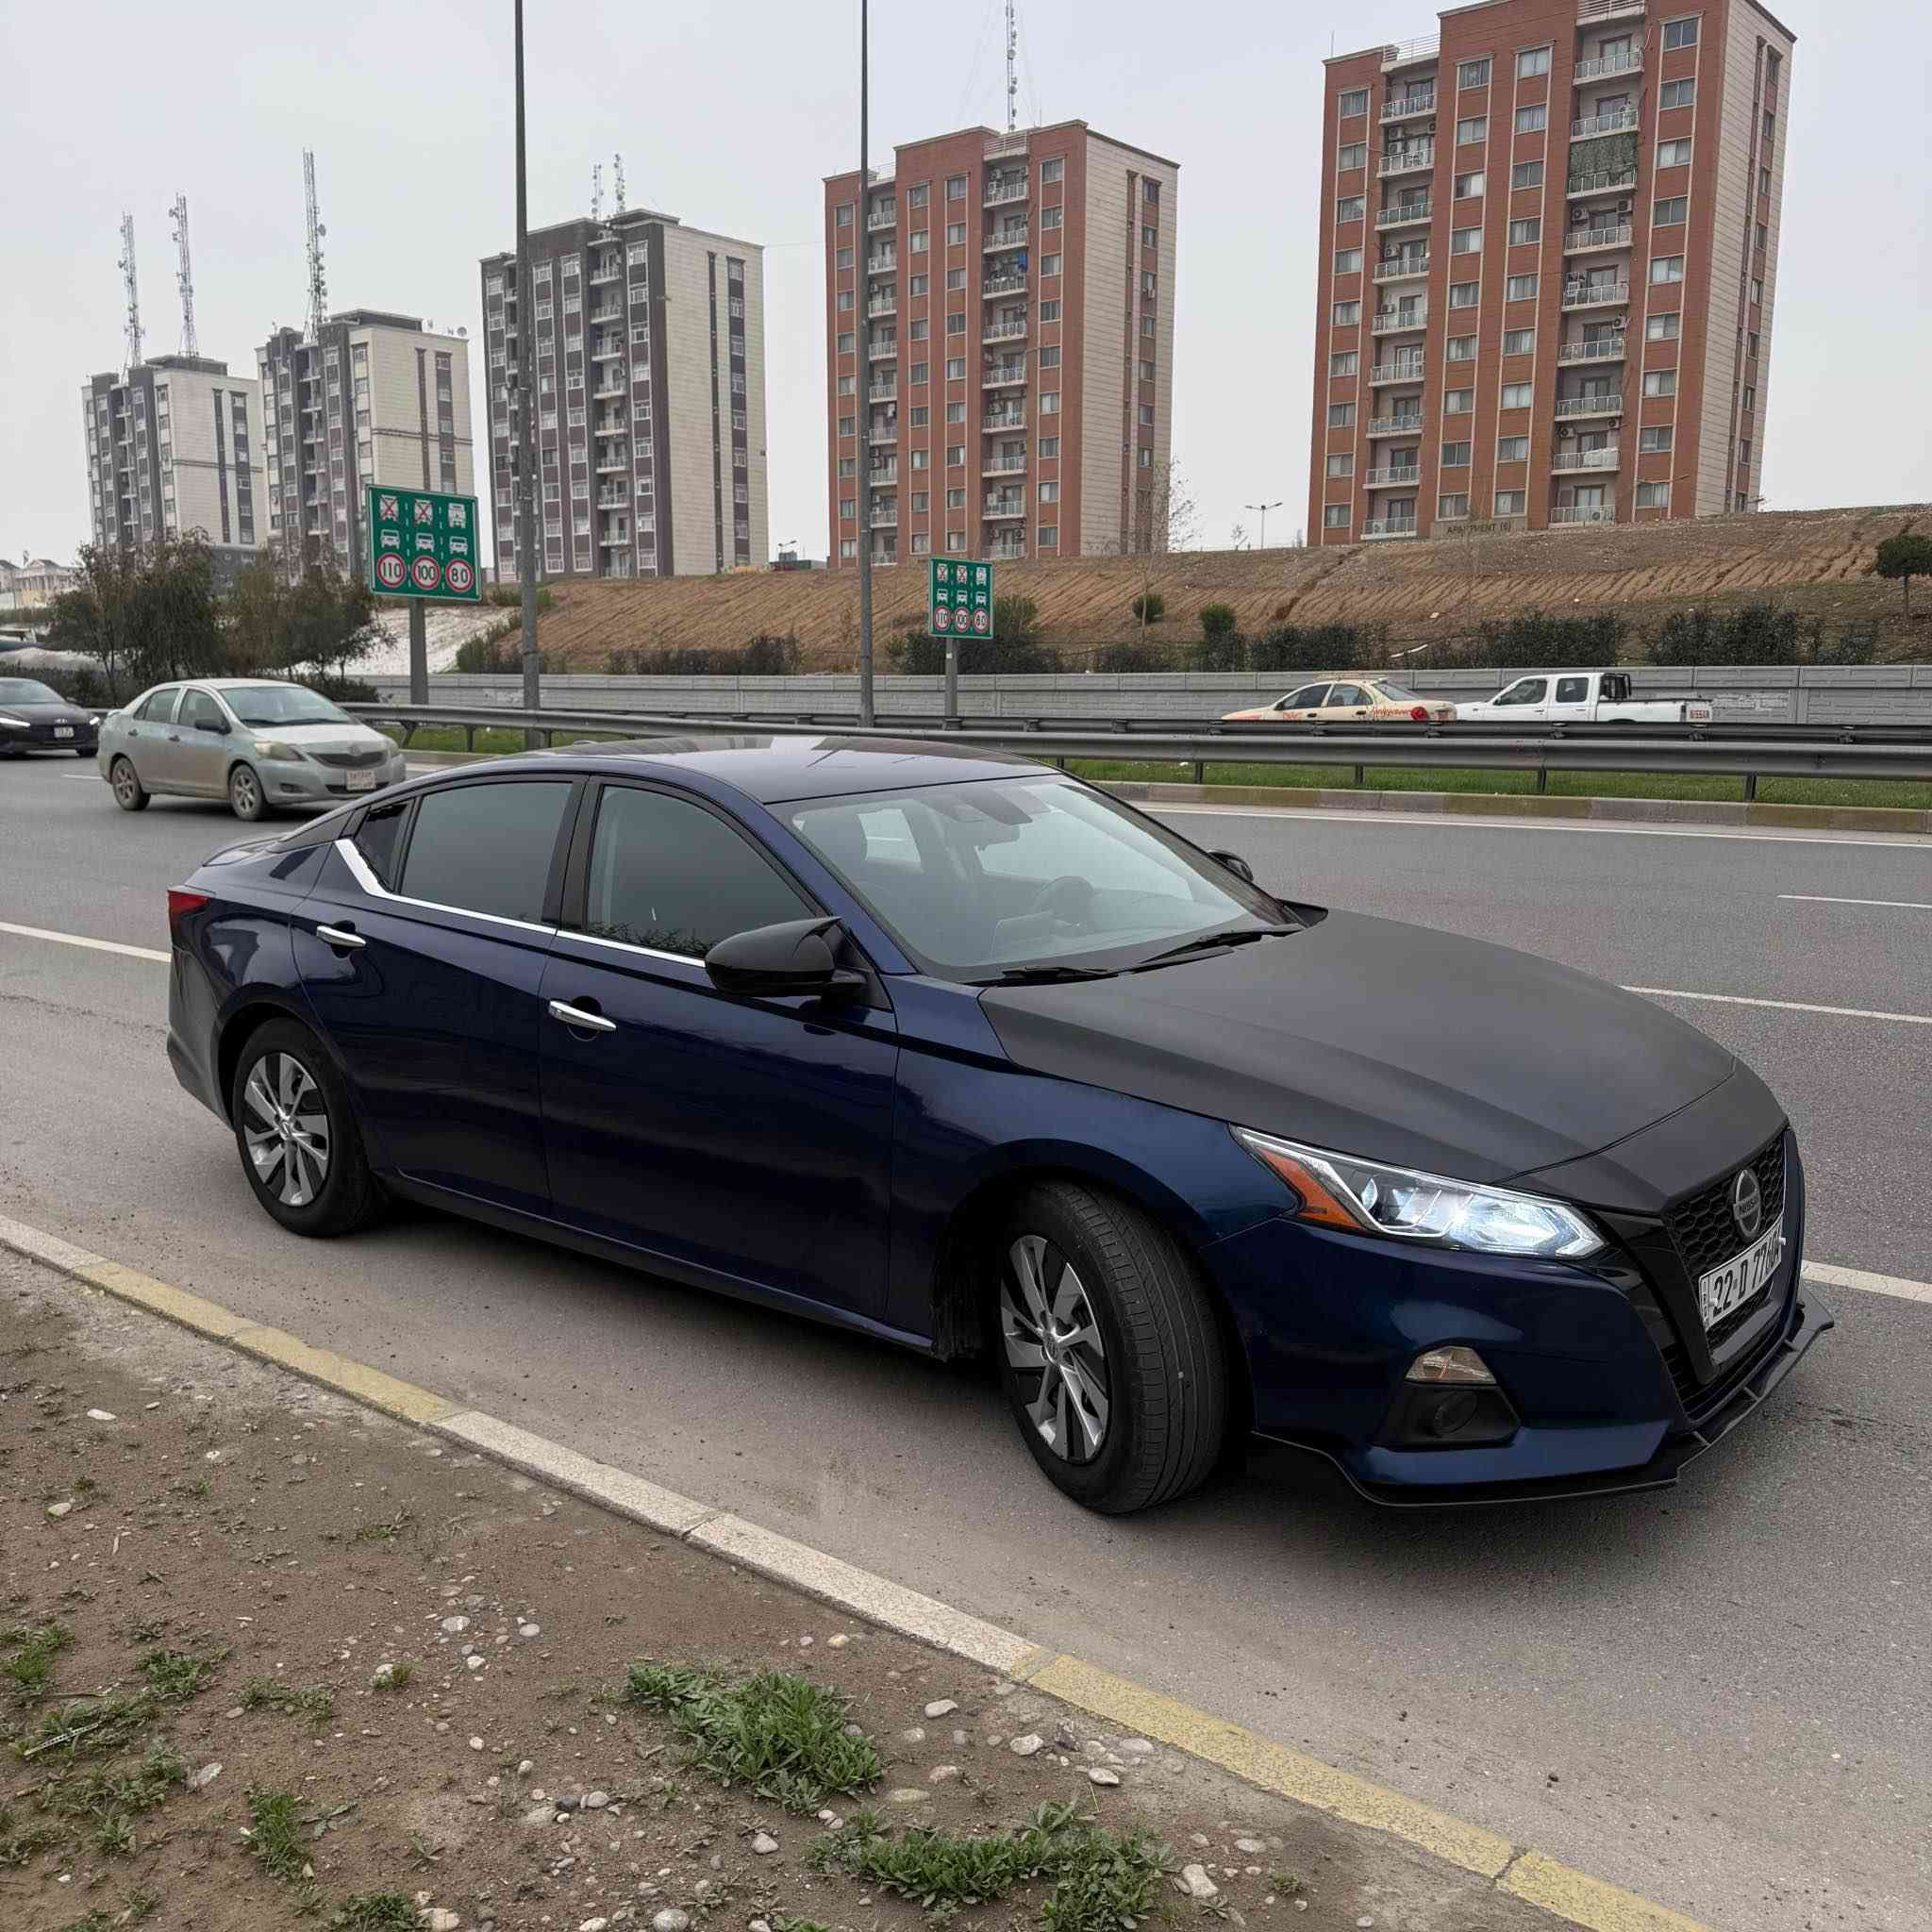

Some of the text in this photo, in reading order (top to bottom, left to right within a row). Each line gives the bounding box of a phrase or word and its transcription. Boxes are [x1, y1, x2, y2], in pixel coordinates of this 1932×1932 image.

[383, 562, 468, 583] 110 100 80
[1712, 1270, 1733, 1317] 22
